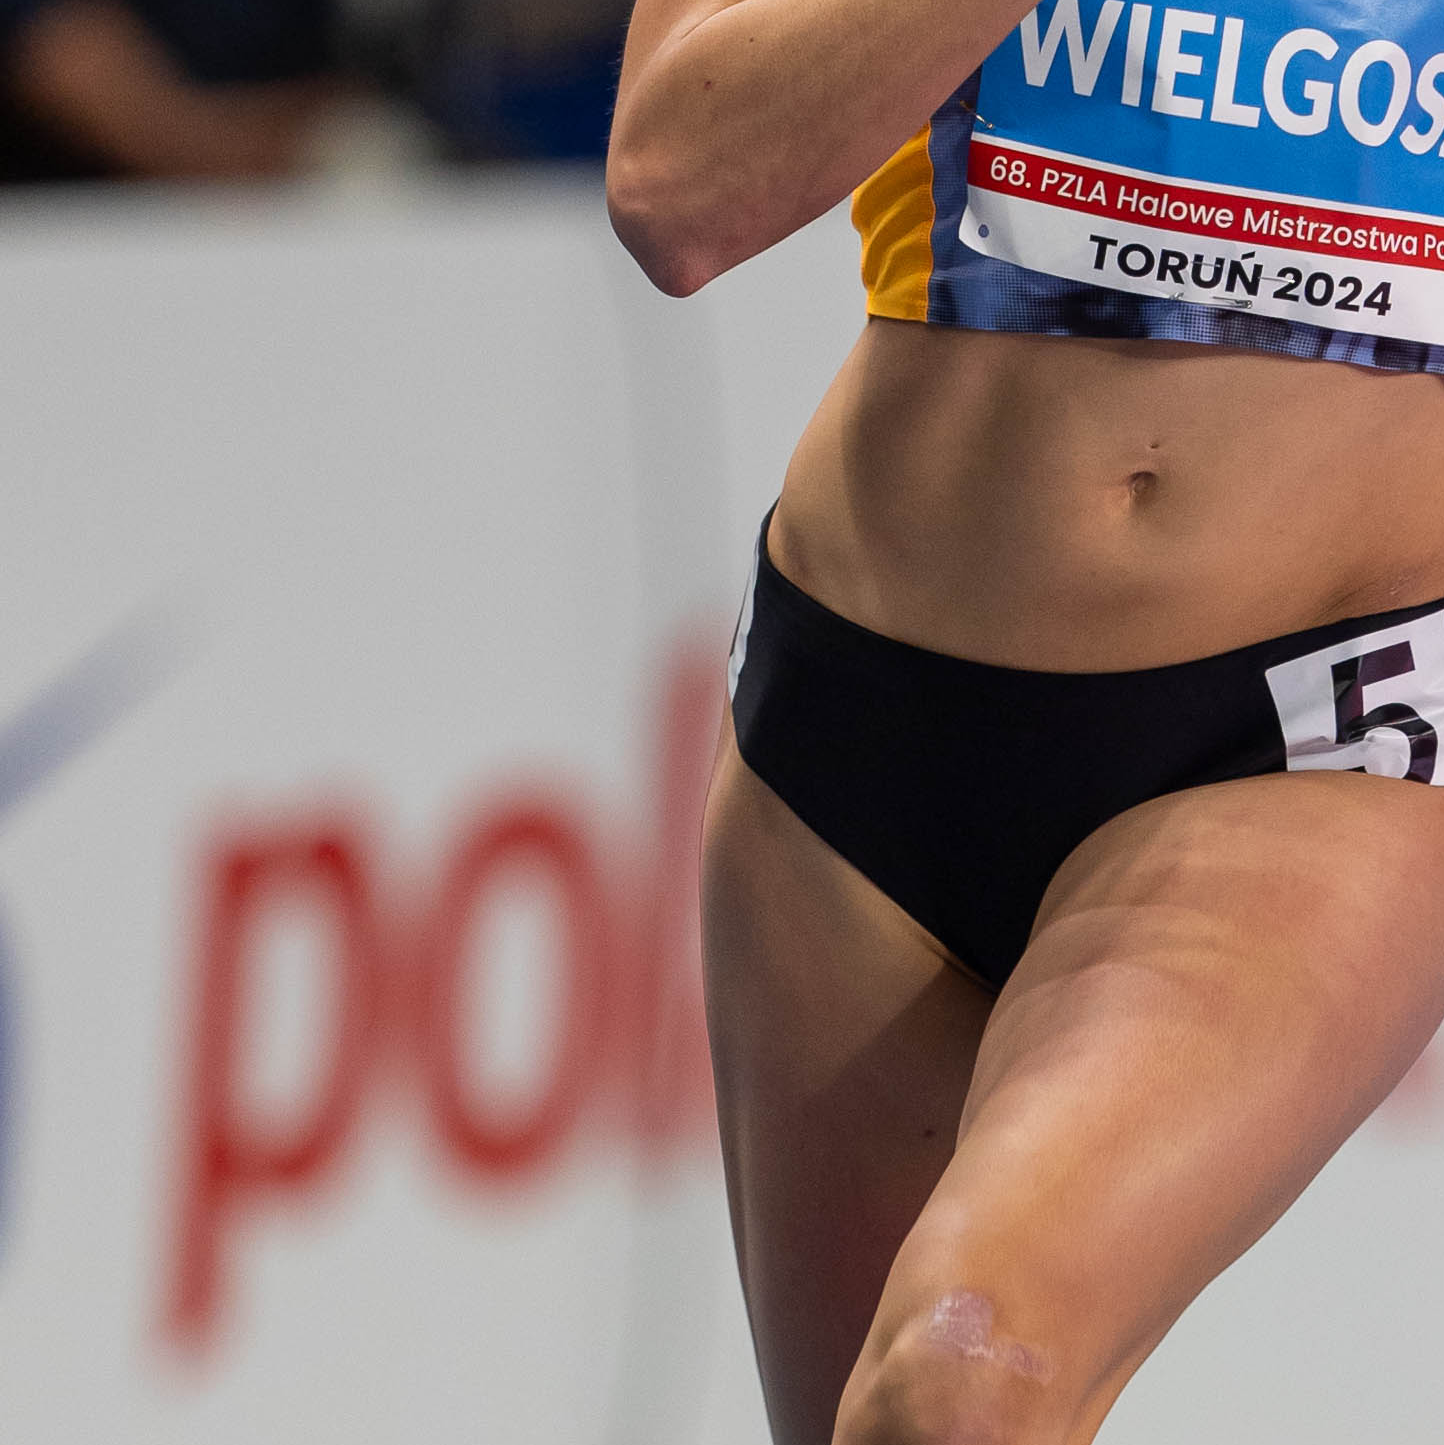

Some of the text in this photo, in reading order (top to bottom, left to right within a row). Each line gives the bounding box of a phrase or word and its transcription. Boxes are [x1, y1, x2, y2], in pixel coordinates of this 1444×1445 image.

[989, 154, 1032, 189] 68.
[1040, 167, 1108, 206] PZLA
[1116, 184, 1235, 230] Halowe
[1242, 207, 1418, 256] Mistrzostwa
[1089, 233, 1393, 316] TORUŃ 2024
[1330, 640, 1439, 786] 5
